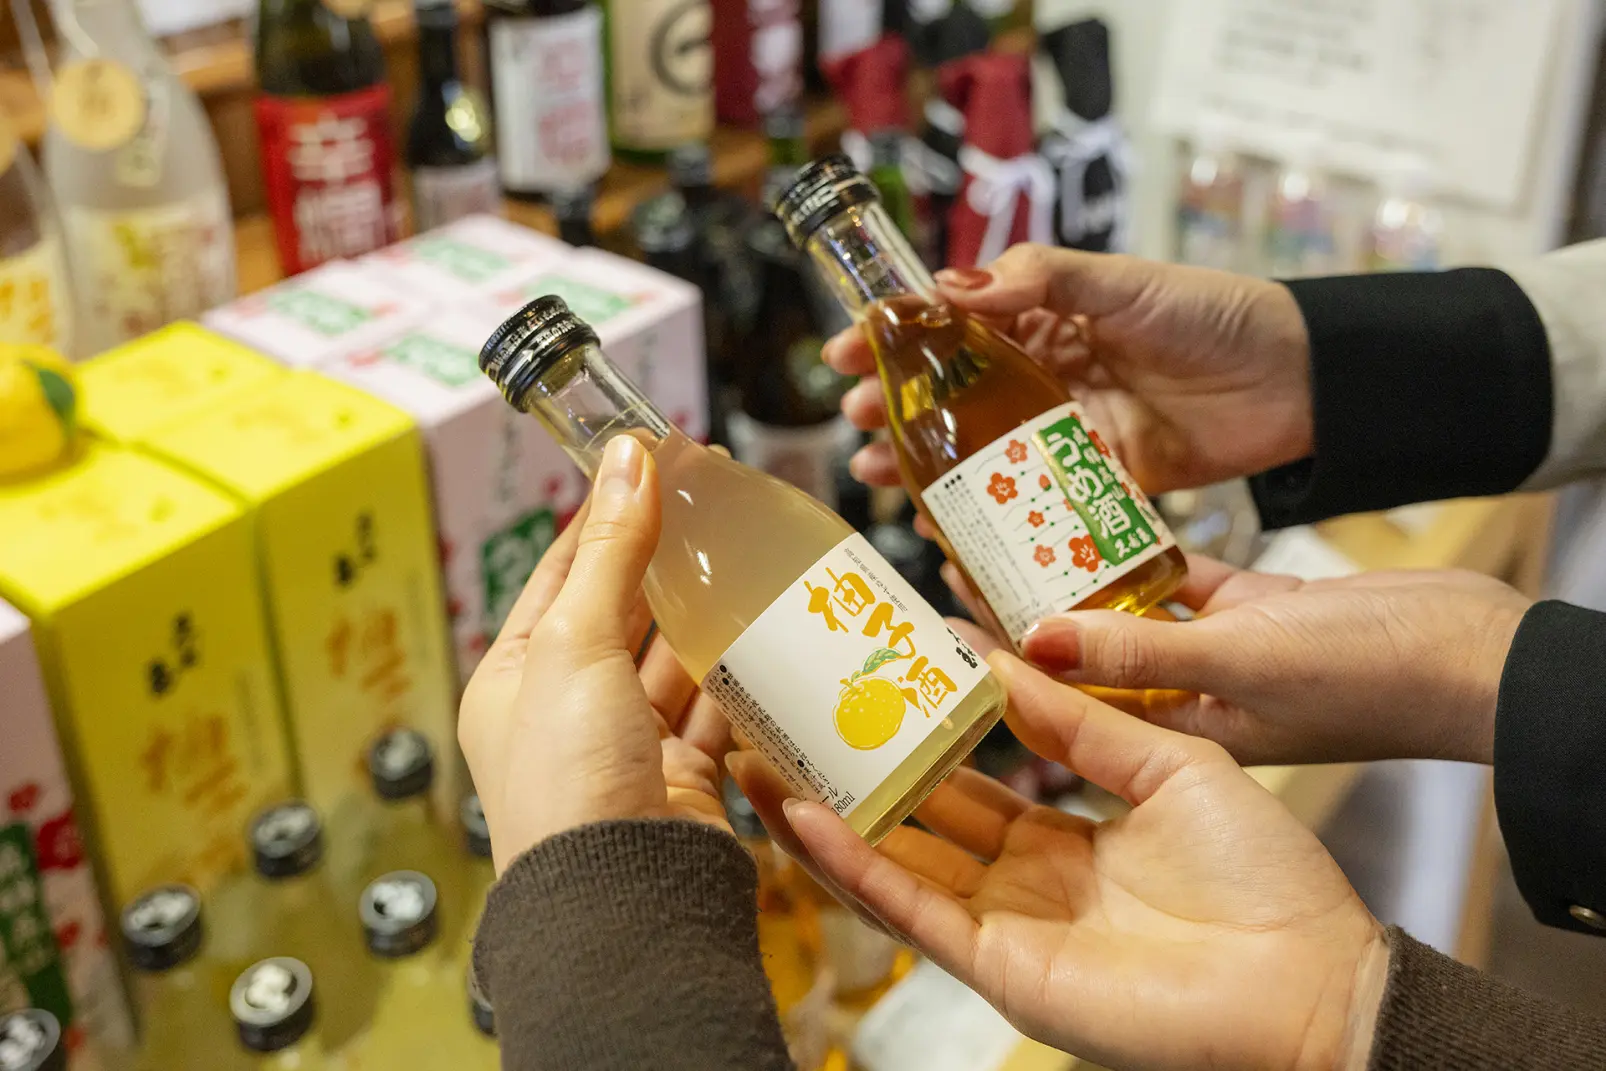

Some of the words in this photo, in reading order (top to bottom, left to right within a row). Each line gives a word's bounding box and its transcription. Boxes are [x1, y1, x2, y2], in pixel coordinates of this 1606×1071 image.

[1046, 432, 1131, 540] うめ酒
[804, 567, 957, 718] 柚子酒
[817, 787, 839, 806] ール
[833, 791, 856, 816] 180ml
